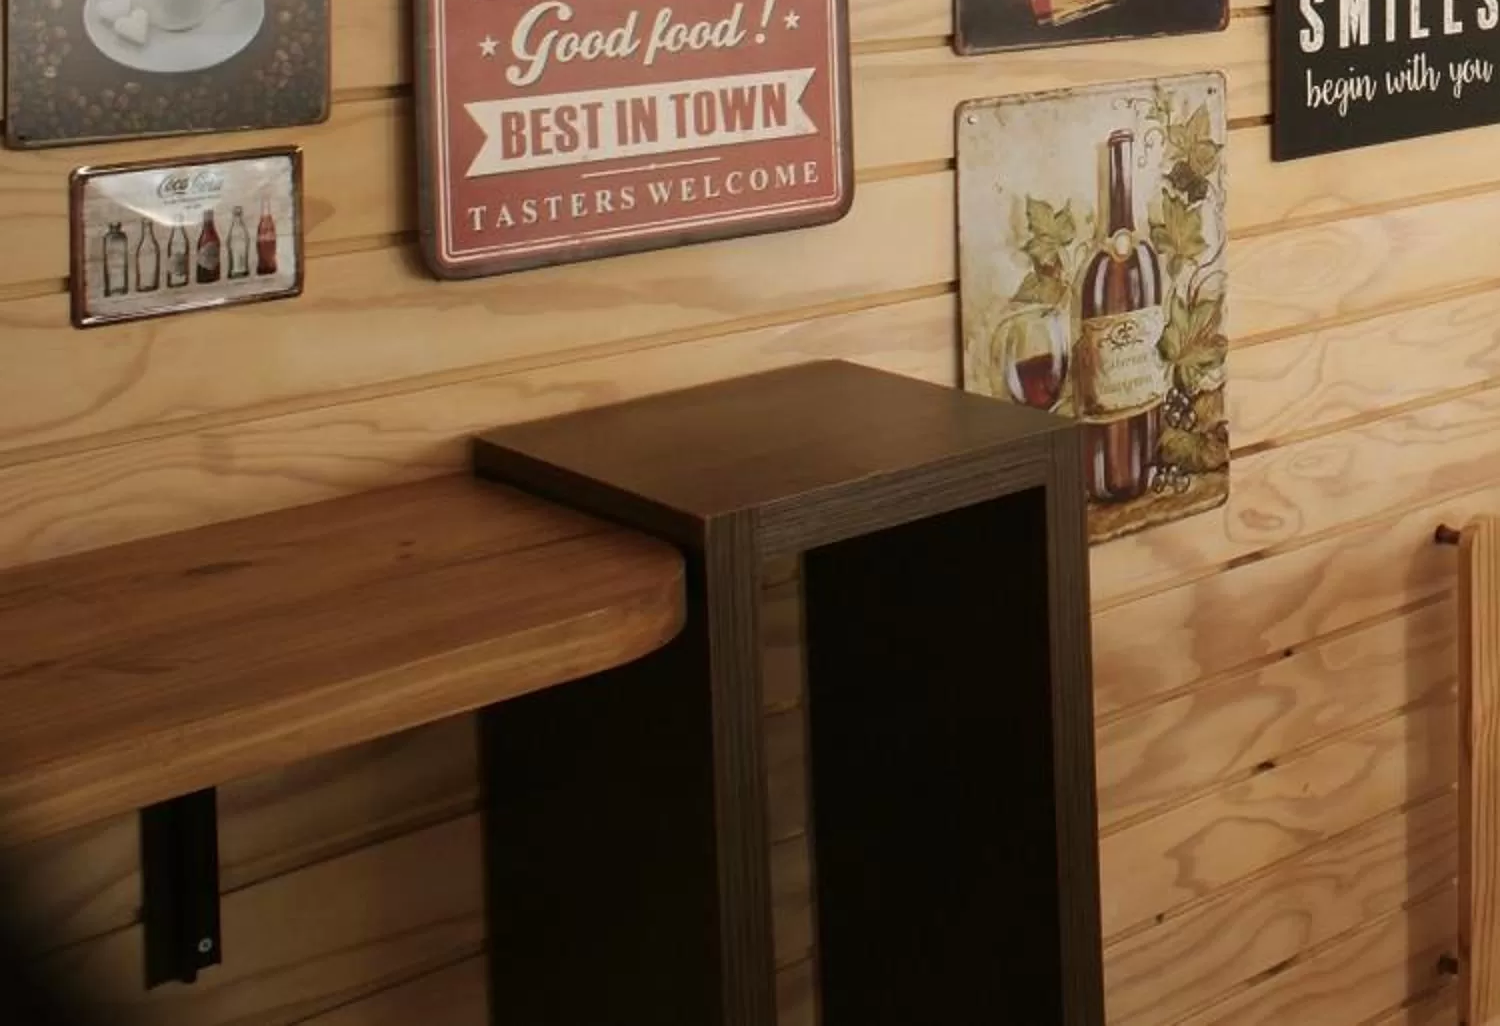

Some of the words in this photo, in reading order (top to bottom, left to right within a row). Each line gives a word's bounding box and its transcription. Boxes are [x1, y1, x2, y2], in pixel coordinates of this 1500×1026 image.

[506, 0, 640, 87] Good
[643, 2, 747, 65] food
[501, 101, 603, 160] BEST
[615, 95, 659, 147] IN
[670, 82, 788, 139] TOWN
[1306, 66, 1377, 118] begin
[1385, 51, 1441, 95] with
[1449, 57, 1494, 100] you
[468, 185, 637, 232] TASTERS
[646, 160, 821, 205] WELCOME
